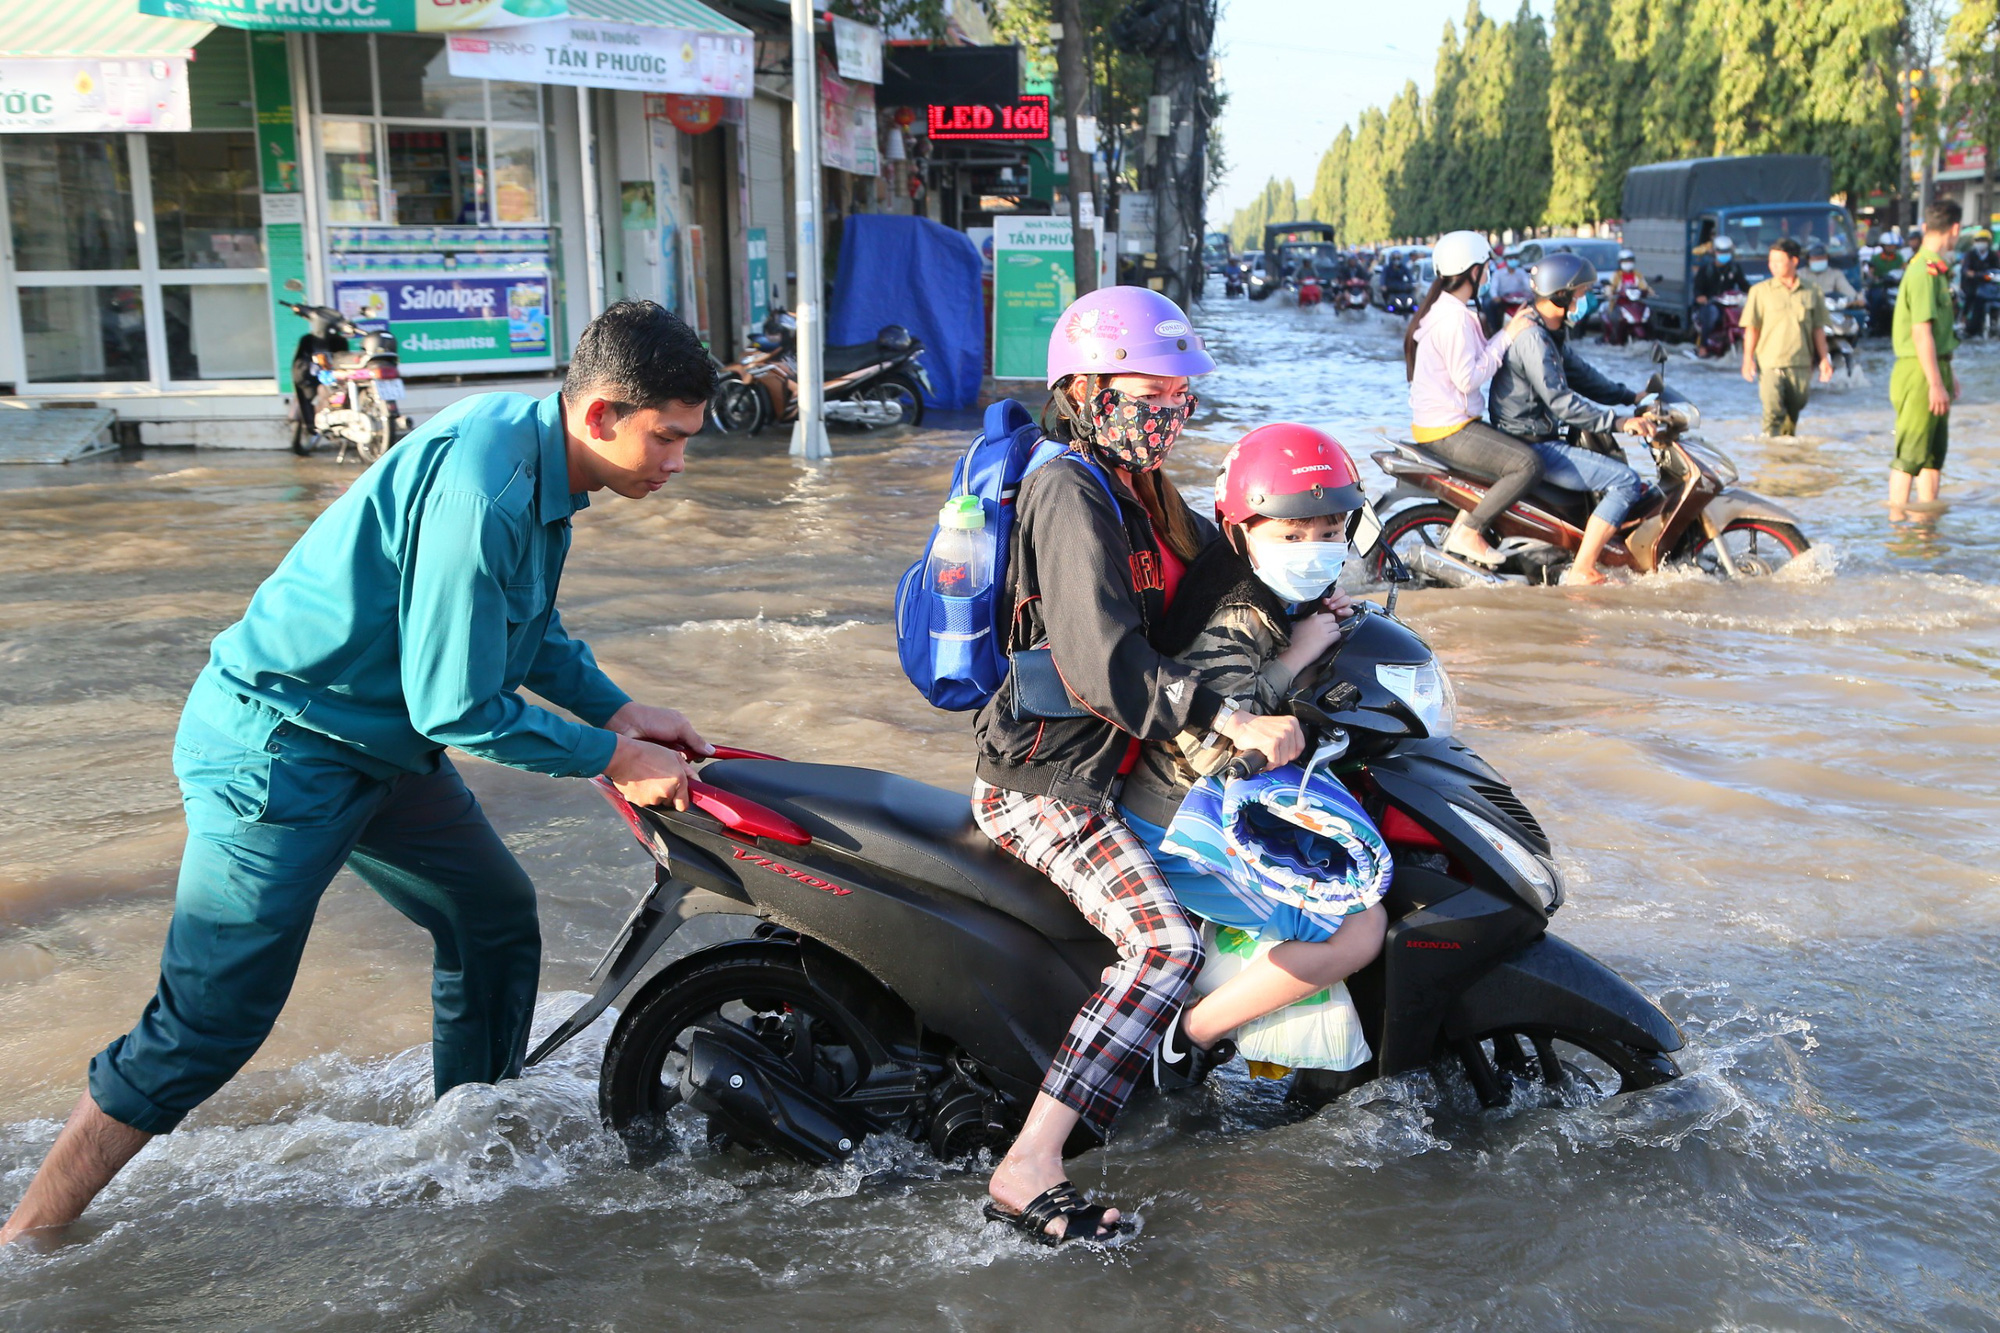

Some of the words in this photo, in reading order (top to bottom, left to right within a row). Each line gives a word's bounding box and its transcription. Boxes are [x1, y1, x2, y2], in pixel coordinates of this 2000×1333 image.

[0, 88, 53, 114] ỚC
[933, 105, 994, 129] LED
[1002, 105, 1044, 129] 160
[399, 284, 496, 313] Salonpas
[1291, 464, 1333, 475] HONDA
[730, 845, 854, 896] VISION
[1406, 940, 1463, 950] HONDA
